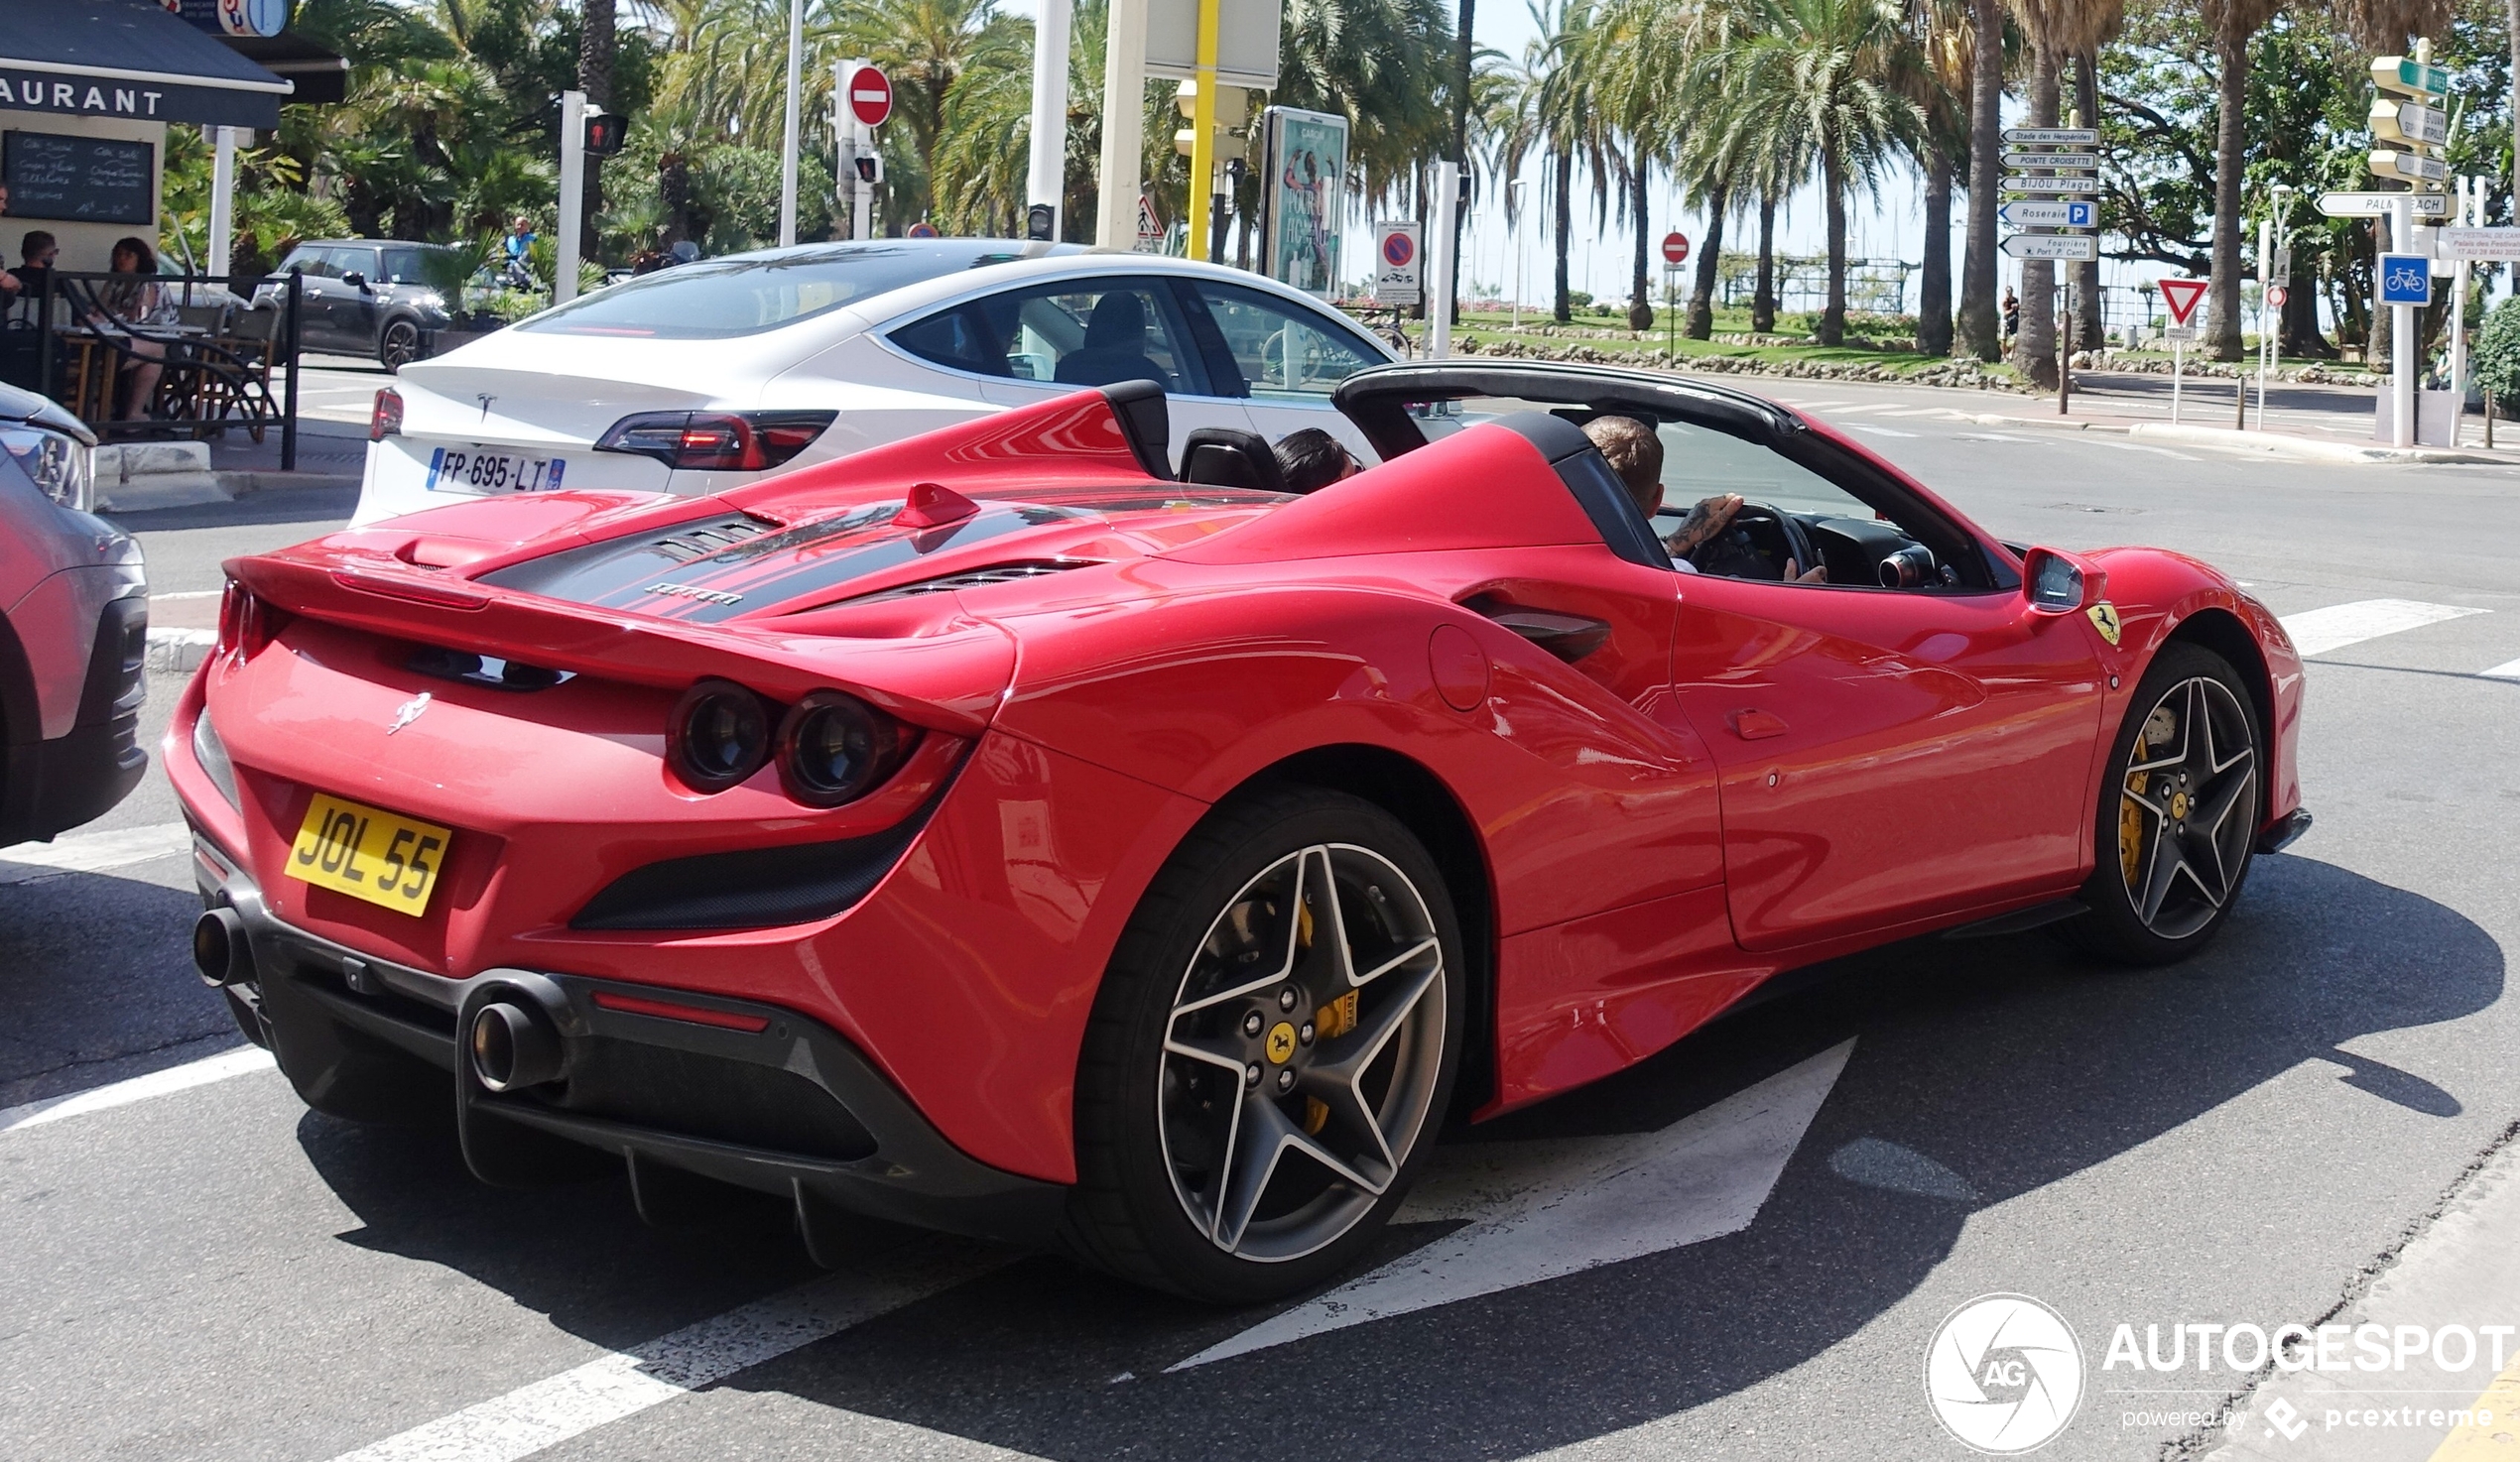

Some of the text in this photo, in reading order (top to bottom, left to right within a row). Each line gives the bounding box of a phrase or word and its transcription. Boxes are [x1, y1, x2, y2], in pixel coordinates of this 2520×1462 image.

[2053, 132, 2091, 143] Hespérides
[2020, 156, 2047, 165] POINTE
[2021, 179, 2089, 192] BIJOU Plage
[2411, 198, 2440, 210] EACH
[2022, 206, 2084, 222] Roseraie P
[2048, 238, 2087, 247] Fourrière
[298, 808, 441, 900] JOL 55
